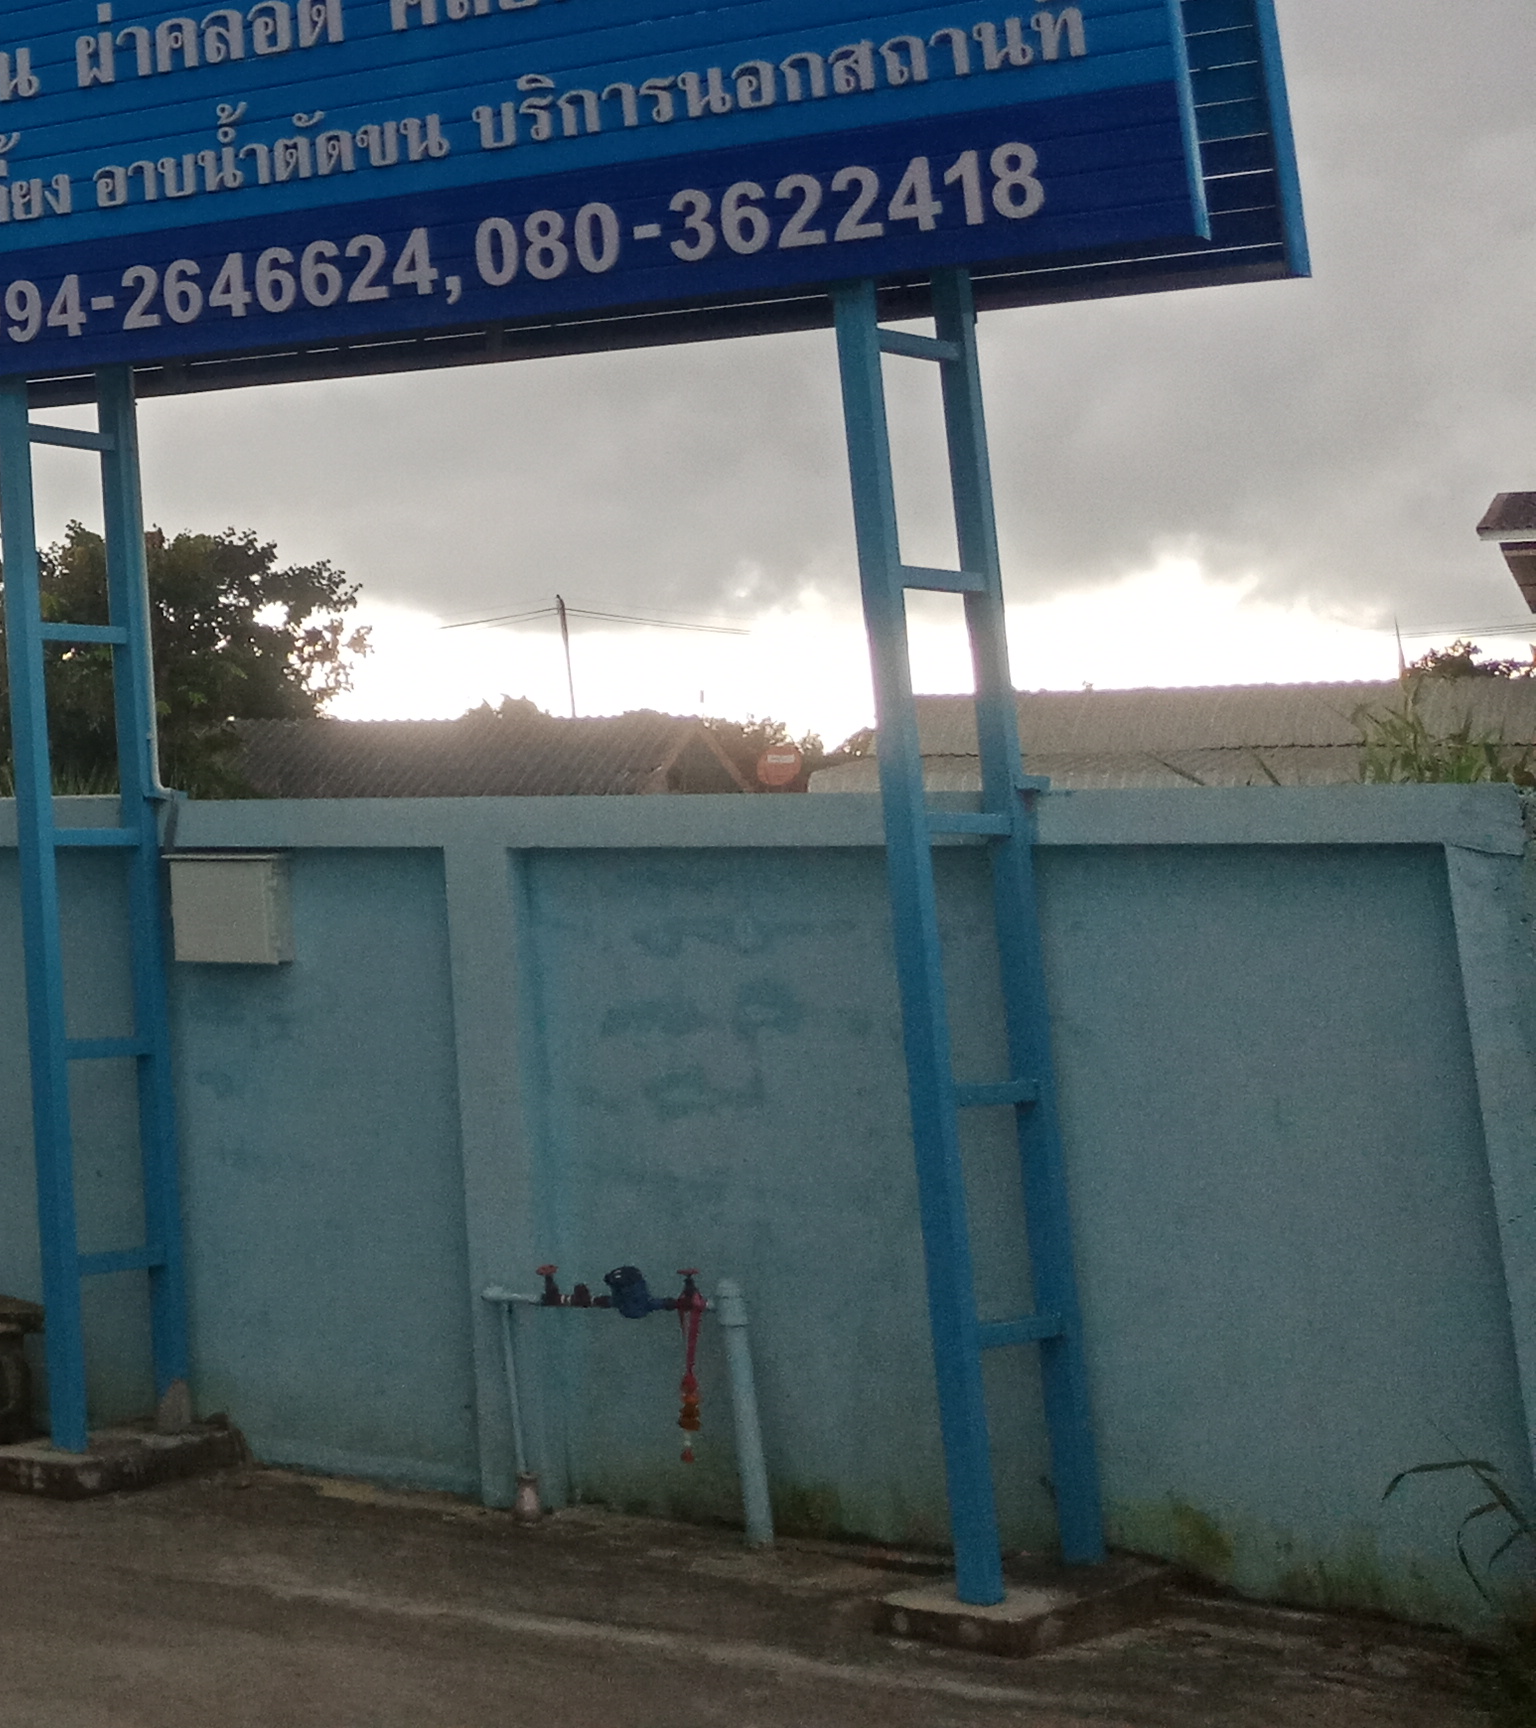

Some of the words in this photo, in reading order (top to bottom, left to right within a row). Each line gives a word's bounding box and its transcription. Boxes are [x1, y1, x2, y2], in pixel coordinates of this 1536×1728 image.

[75, 2, 347, 89] ผ่าคลอด
[92, 100, 453, 209] อาบน้ำตัดขน
